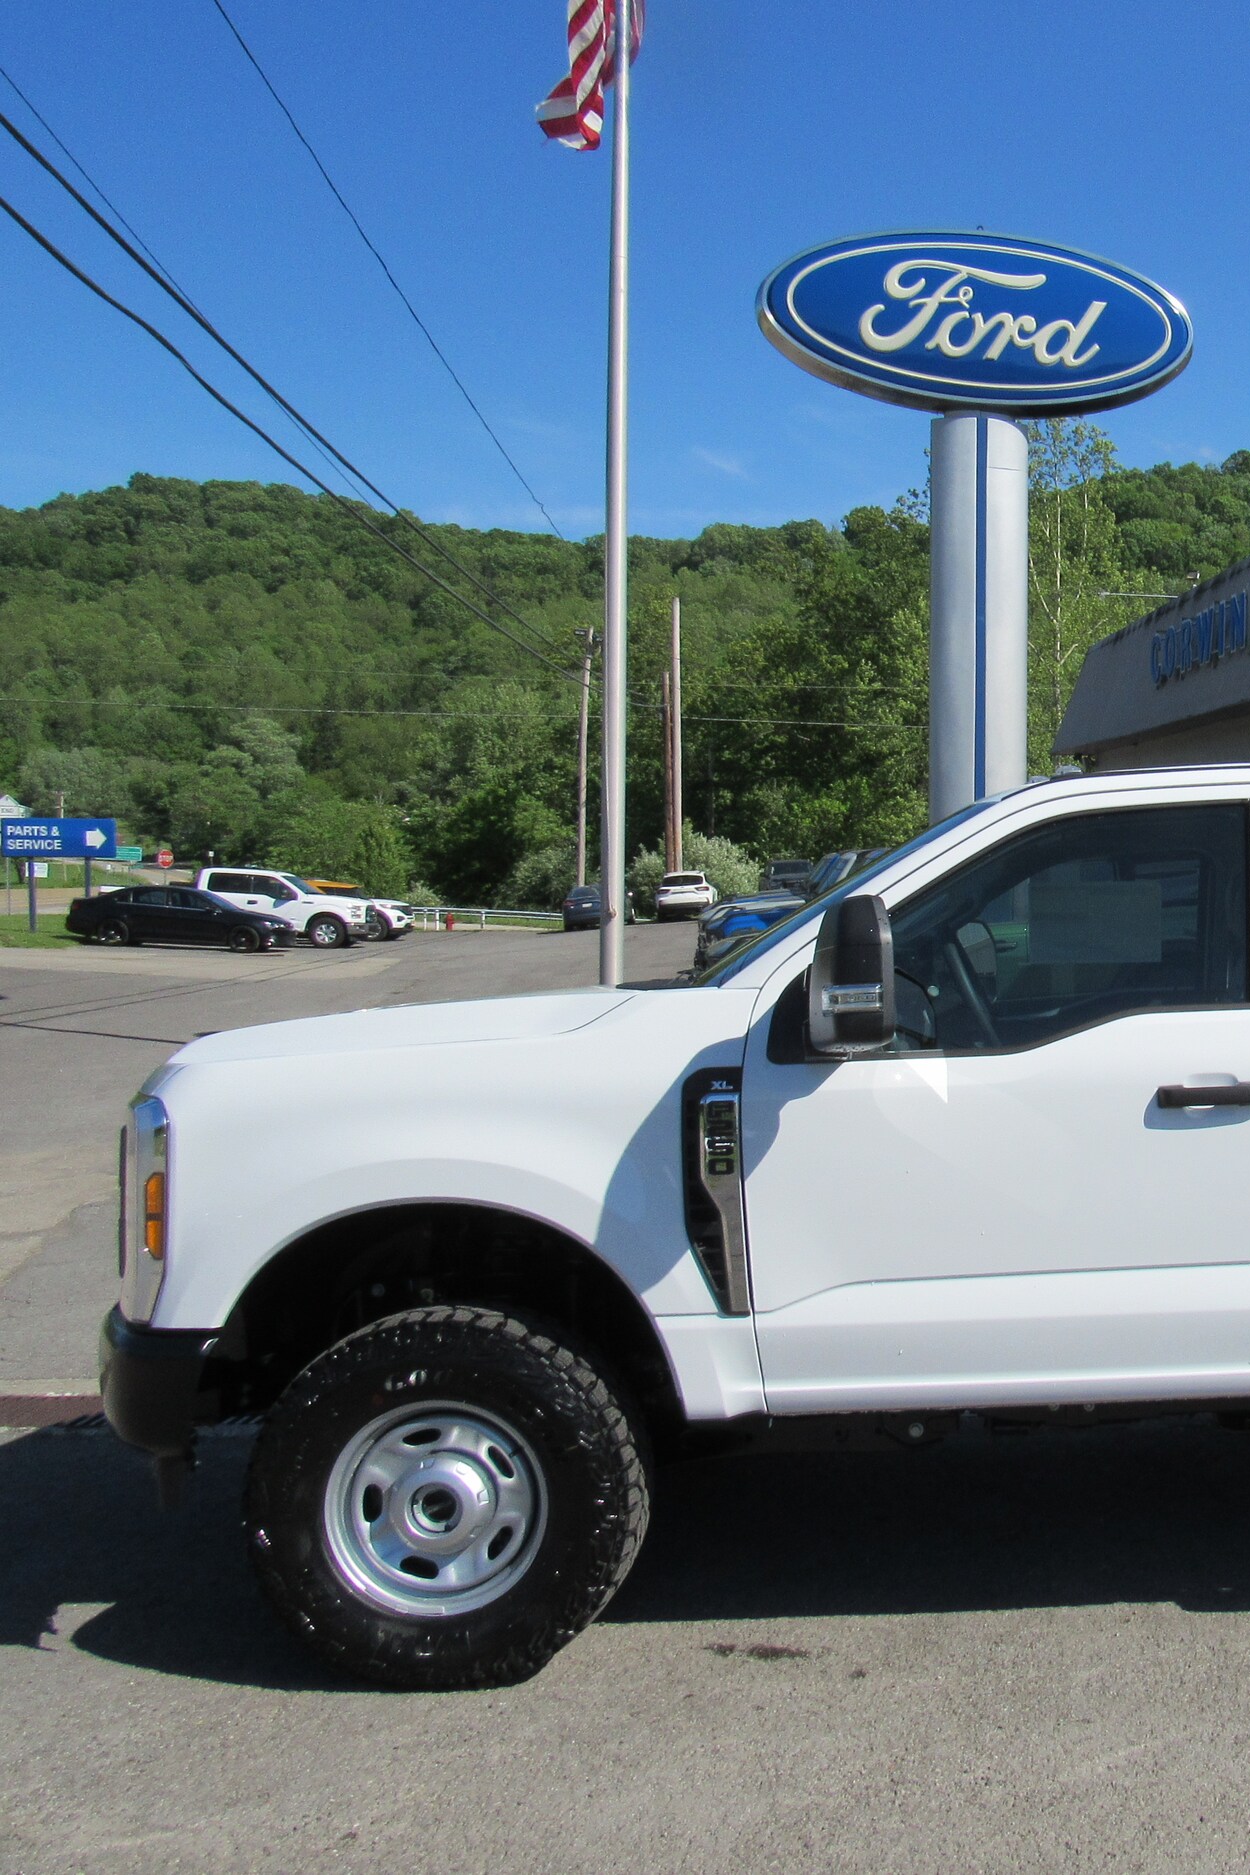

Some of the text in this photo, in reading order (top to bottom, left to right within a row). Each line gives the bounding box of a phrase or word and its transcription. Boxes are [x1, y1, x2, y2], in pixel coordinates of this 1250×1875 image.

[858, 258, 1107, 368] Ford
[7, 825, 60, 836] PARTS &
[7, 839, 62, 850] SERVICE
[711, 1081, 733, 1090] XL
